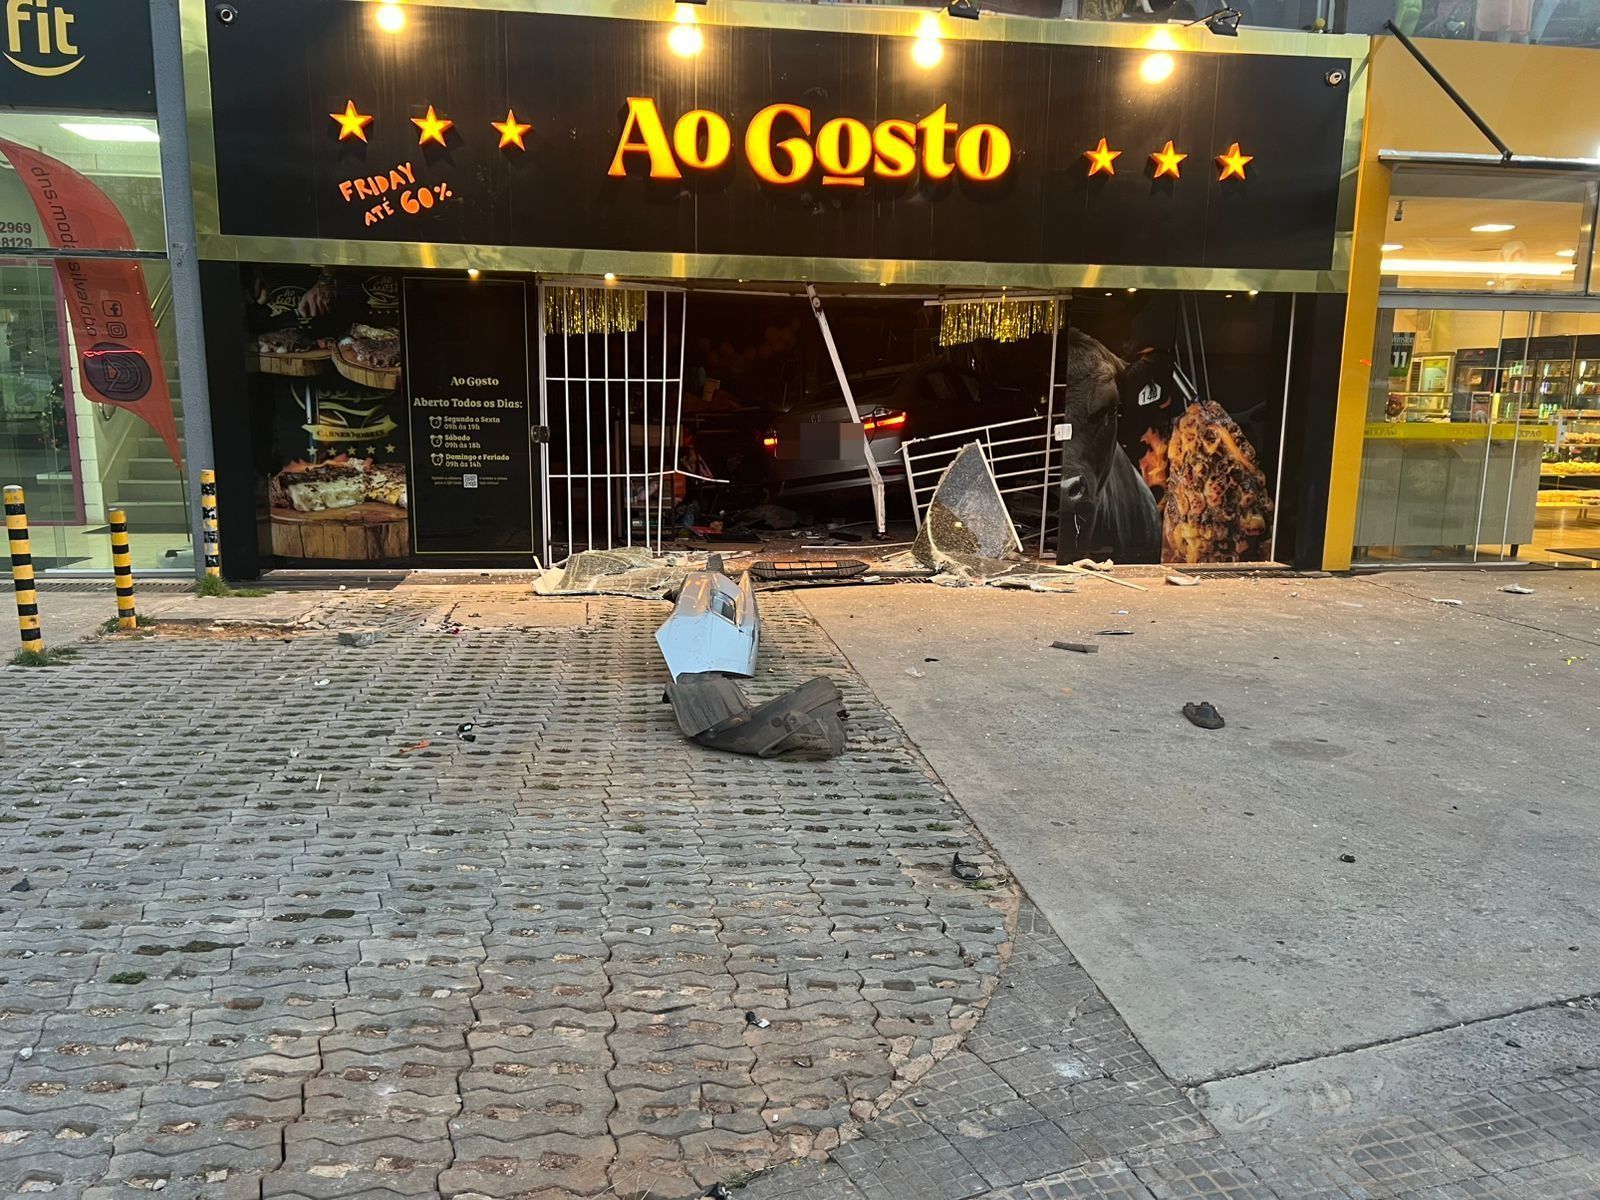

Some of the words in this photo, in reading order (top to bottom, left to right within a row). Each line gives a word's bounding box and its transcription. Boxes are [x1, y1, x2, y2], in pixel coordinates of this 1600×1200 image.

[6, 0, 78, 55] fit
[607, 96, 732, 179] Ao
[744, 102, 1012, 186] Gosto
[338, 162, 416, 202] FRIDAY
[364, 197, 395, 226] ATÉ
[400, 182, 453, 214] 60%
[0, 222, 32, 234] 2969
[1392, 351, 1408, 368] 11
[450, 376, 465, 386] Ao
[466, 376, 499, 387] Gosto
[413, 397, 450, 407] Aberto
[451, 398, 482, 408] Todos
[483, 400, 495, 408] os
[497, 398, 524, 409] Dias:
[443, 415, 474, 424] Segunda
[480, 416, 501, 424] Sexta
[444, 433, 471, 442] Sábado
[445, 453, 477, 461] Domingo
[483, 453, 510, 461] Feriado
